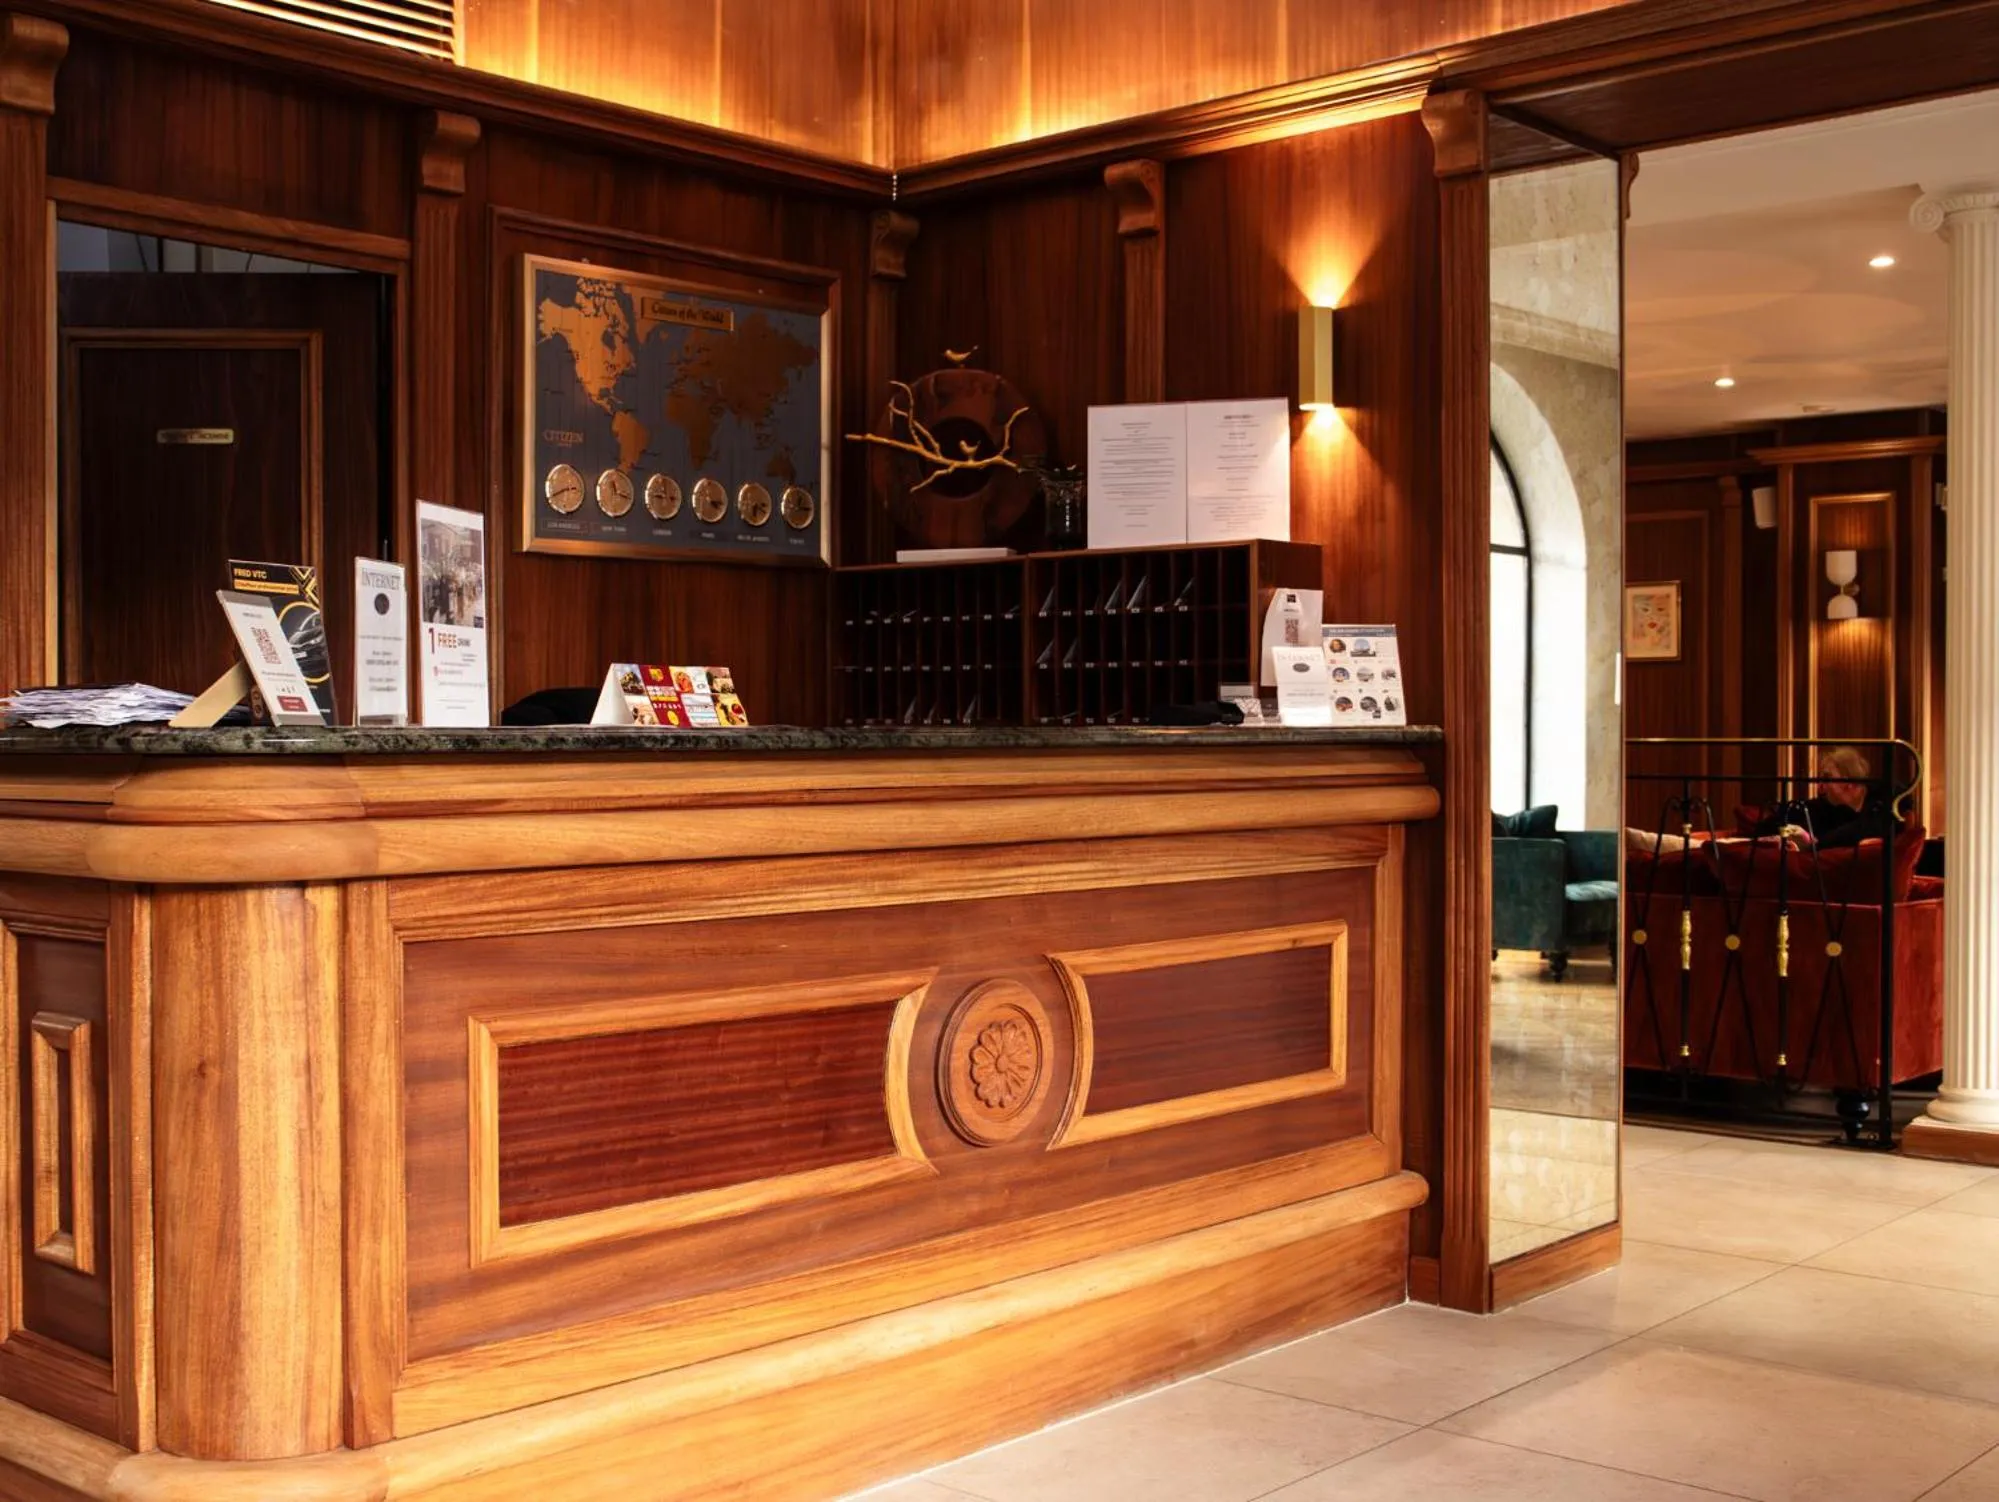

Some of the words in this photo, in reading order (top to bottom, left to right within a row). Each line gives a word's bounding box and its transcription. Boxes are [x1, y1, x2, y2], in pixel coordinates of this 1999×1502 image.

[543, 429, 584, 443] CITIZEN
[234, 567, 252, 578] FRED
[252, 569, 267, 580] VTC
[361, 567, 401, 591] INTERNET
[428, 627, 435, 654] 1
[438, 632, 457, 649] FREE
